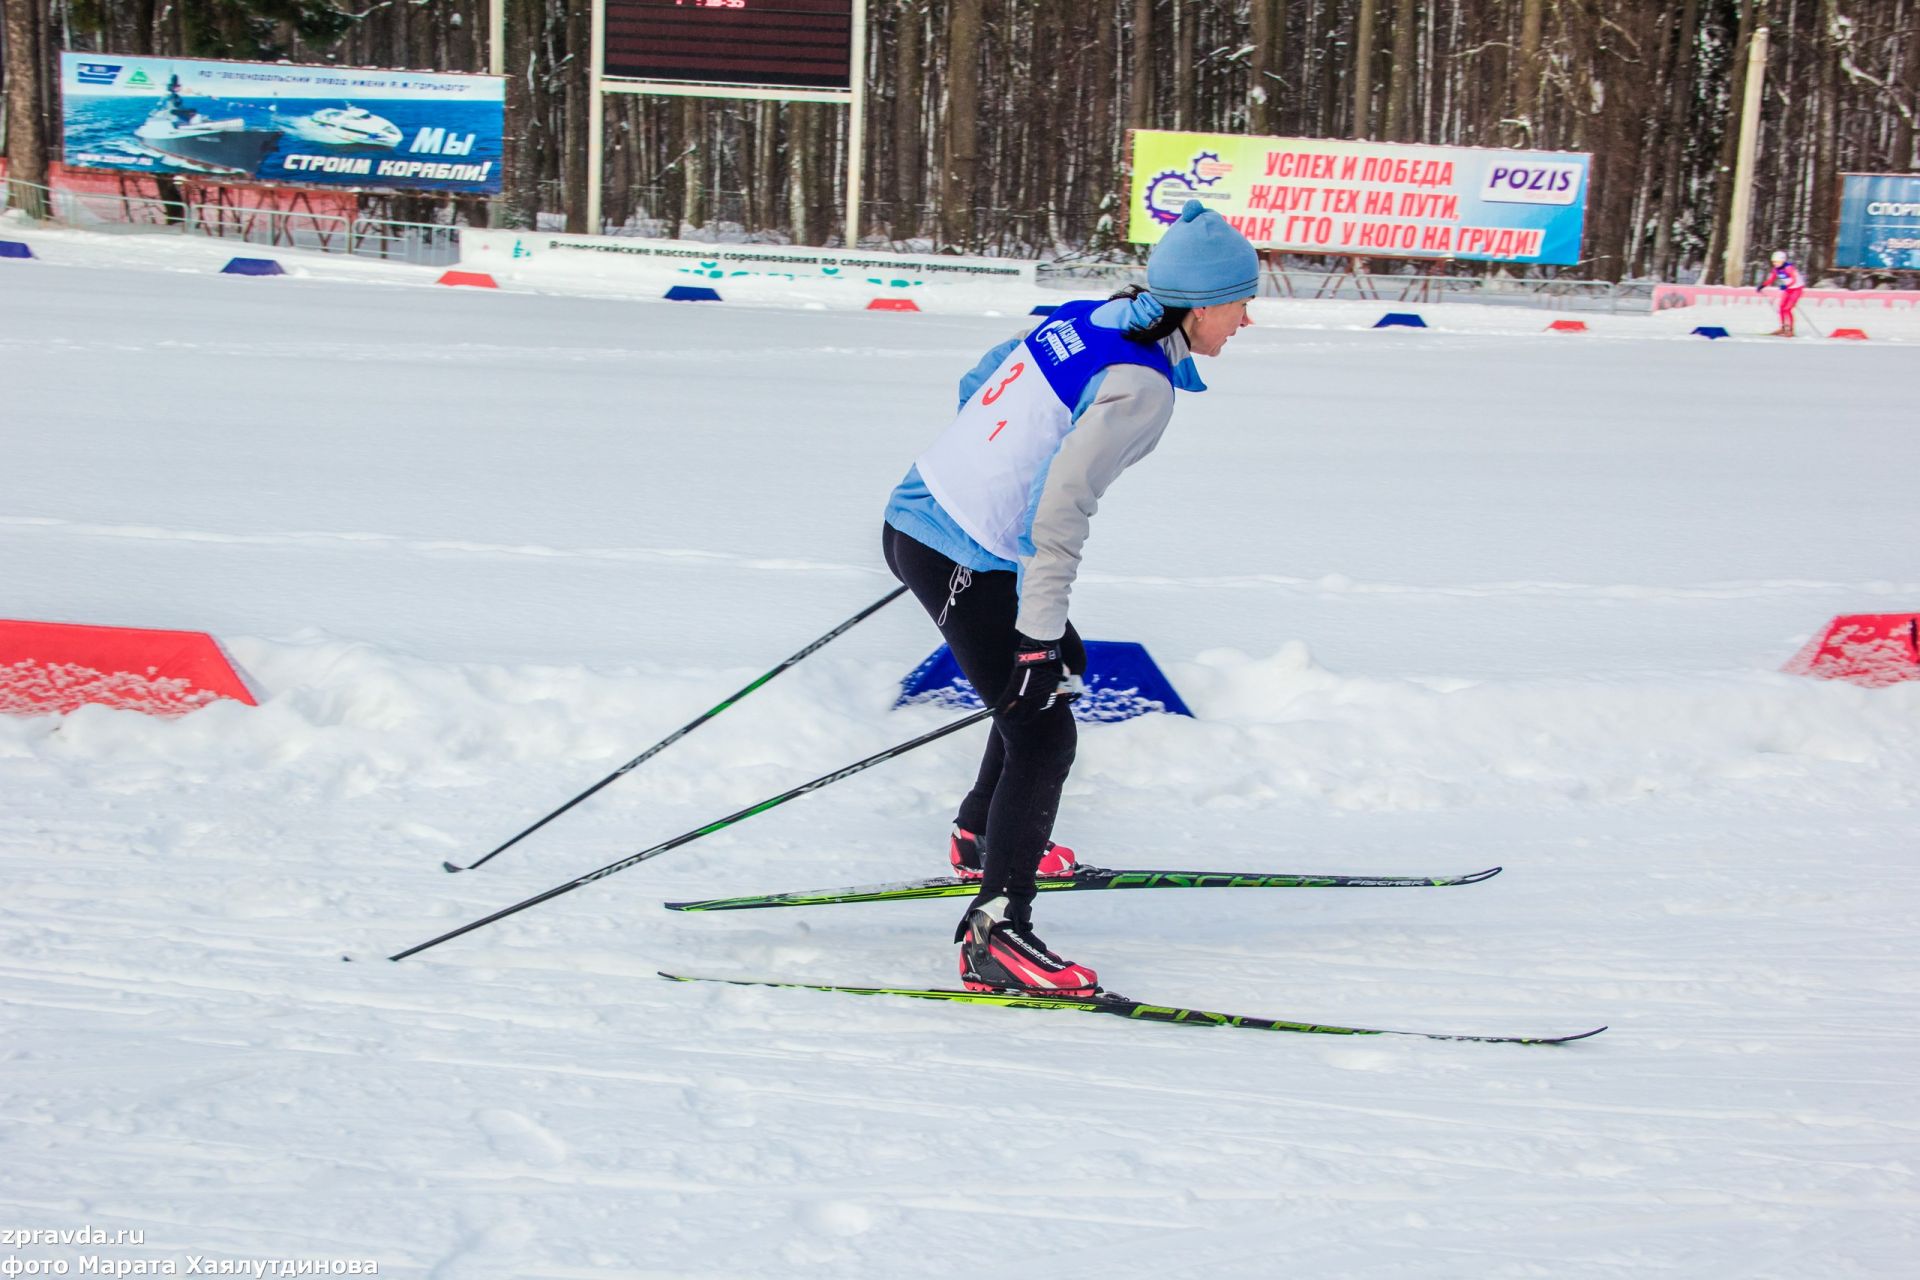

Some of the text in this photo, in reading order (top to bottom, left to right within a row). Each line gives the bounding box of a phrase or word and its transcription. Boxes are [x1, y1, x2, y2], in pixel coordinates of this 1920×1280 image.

[283, 154, 493, 182] СТРОИМ КОРАБЛИ!
[1264, 151, 1338, 180] УСПЕХ
[1340, 155, 1358, 180] И
[1361, 157, 1454, 188] ПОБЕДА
[1488, 167, 1573, 192] POZIS
[1248, 184, 1460, 221] ЖДУТ ТЕХ НА ПУТИ,
[1221, 215, 1275, 241] НАК
[1284, 215, 1333, 245] ГТО
[1358, 222, 1417, 249] КОГО
[1421, 225, 1452, 250] НА
[1456, 228, 1539, 258] ГРУДИ!
[821, 257, 837, 267] по
[981, 362, 1025, 406] 3
[988, 420, 1008, 442] 1
[1107, 872, 1337, 889] FISCHER
[1347, 878, 1426, 887] FISCHER
